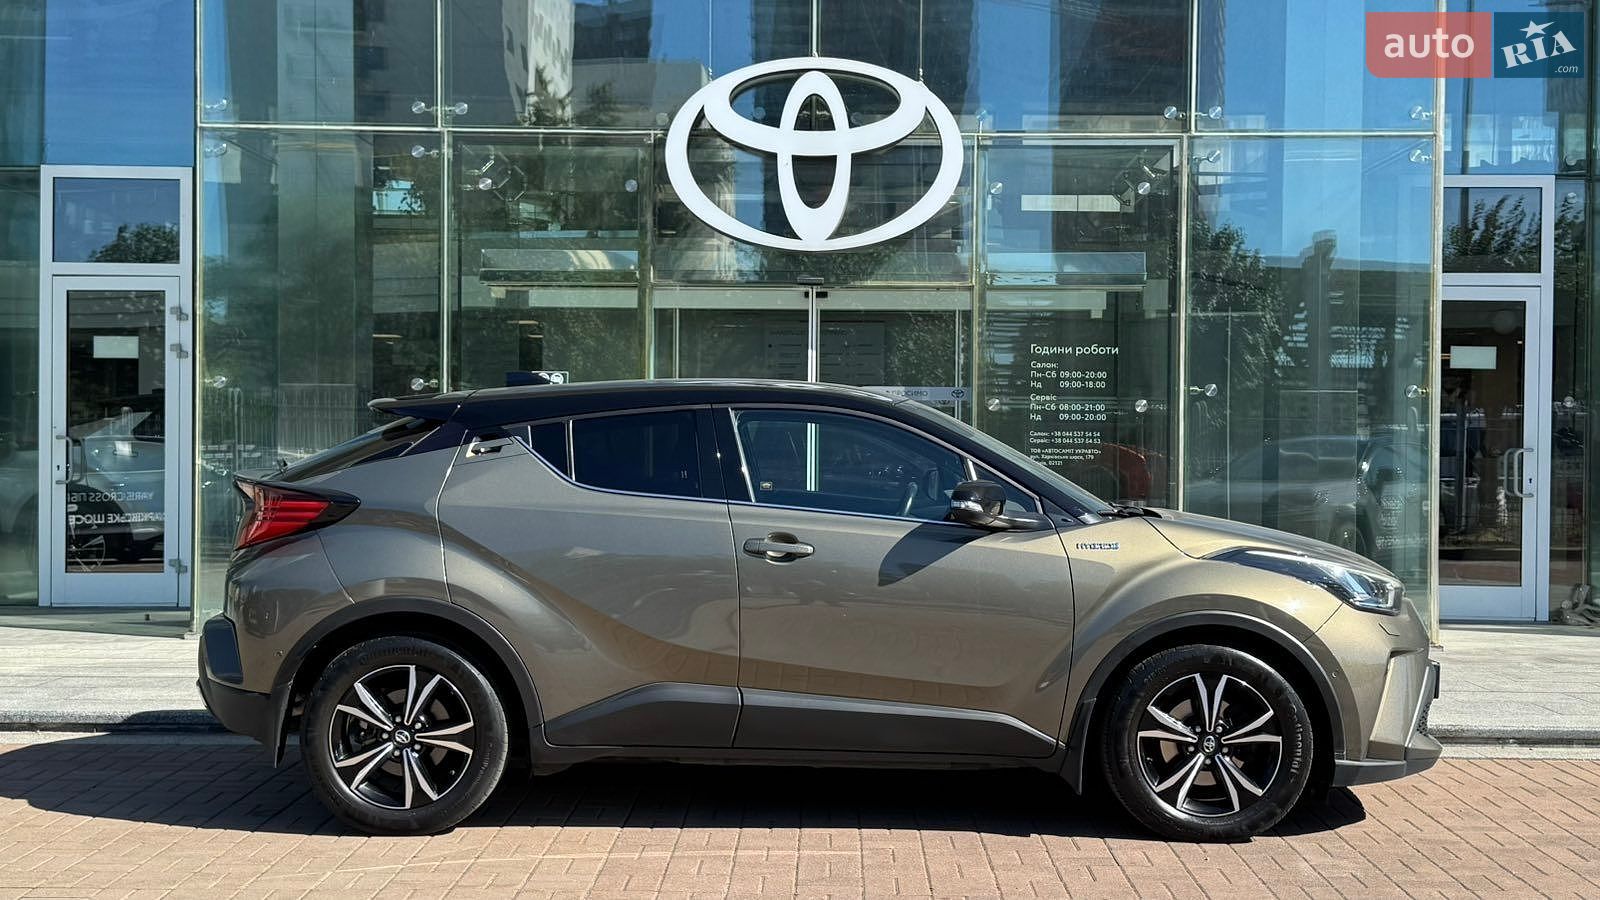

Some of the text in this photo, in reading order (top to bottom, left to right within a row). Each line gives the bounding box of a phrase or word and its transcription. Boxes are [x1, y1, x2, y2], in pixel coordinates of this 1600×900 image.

[1030, 343, 1119, 356] Години роботи
[1030, 360, 1059, 369] Салон:
[1030, 370, 1107, 379] Пн-Сб 09:00-20:00
[1030, 381, 1106, 389] Нд 09:00-18:00
[1030, 403, 1105, 411] Пн-Сб 08:00-21:00
[1030, 413, 1107, 421] Нд 09:00-20:00
